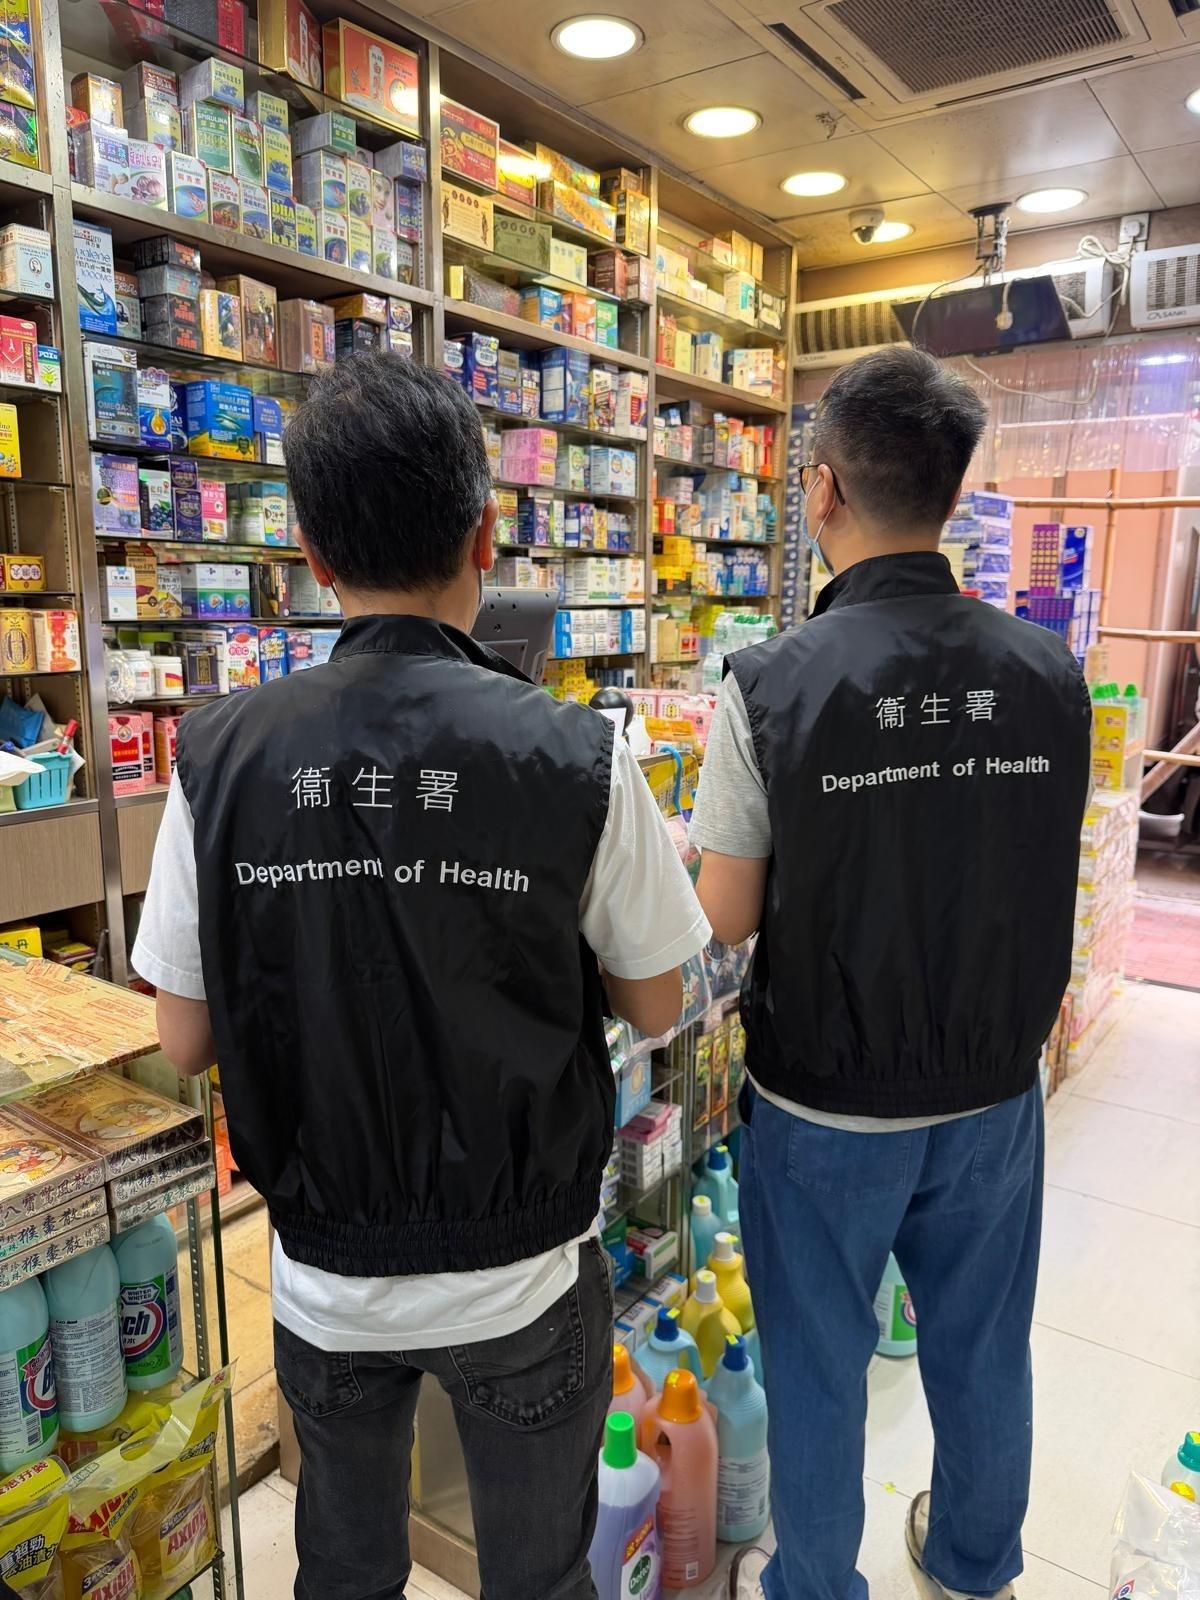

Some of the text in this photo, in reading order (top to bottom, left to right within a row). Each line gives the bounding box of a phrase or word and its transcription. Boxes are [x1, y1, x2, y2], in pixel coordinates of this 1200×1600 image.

[822, 755, 1050, 793] Department of Health
[235, 857, 530, 893] Department of Health
[127, 1288, 152, 1296] WHITER
[123, 1311, 151, 1336] ch
[167, 1504, 208, 1556] AXION
